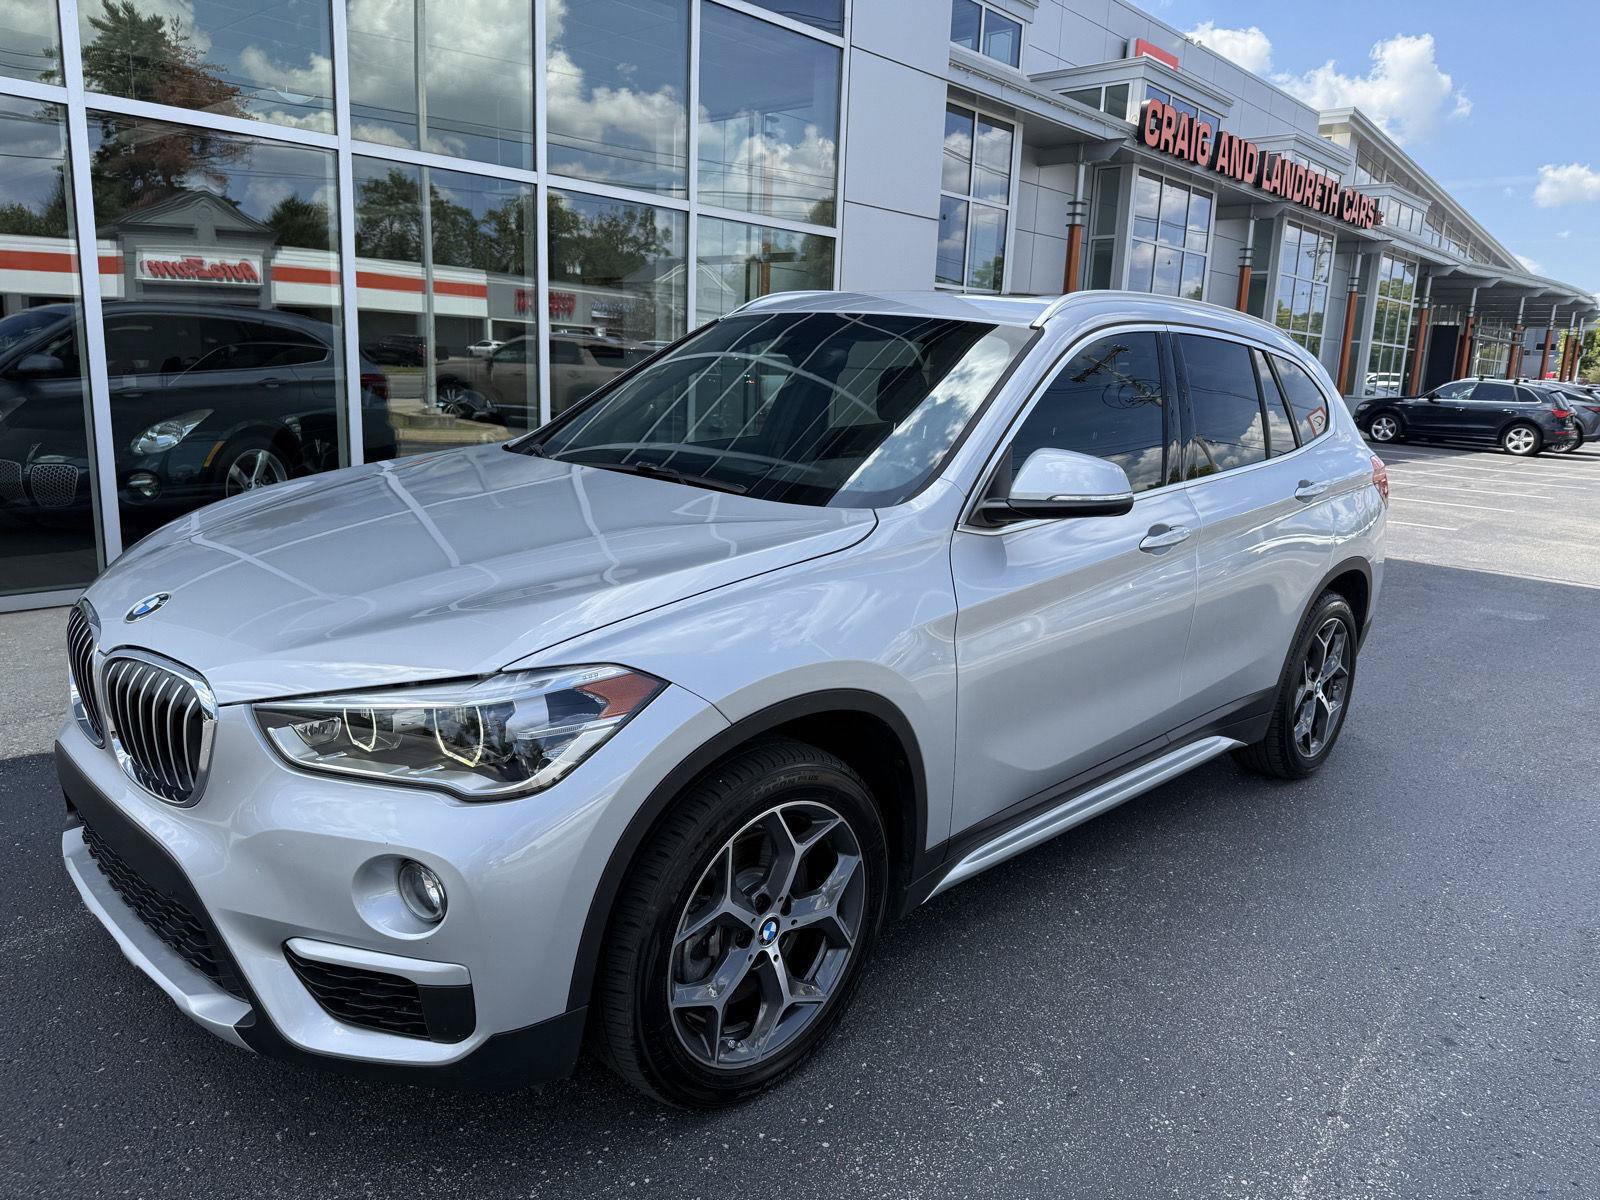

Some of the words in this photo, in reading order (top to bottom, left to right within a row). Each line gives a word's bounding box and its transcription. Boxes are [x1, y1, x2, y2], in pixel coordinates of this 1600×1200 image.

[1144, 99, 1211, 166] CRAIG
[1216, 131, 1258, 184] AND
[1261, 150, 1341, 217] LANDRETH
[1342, 188, 1376, 229] CARS
